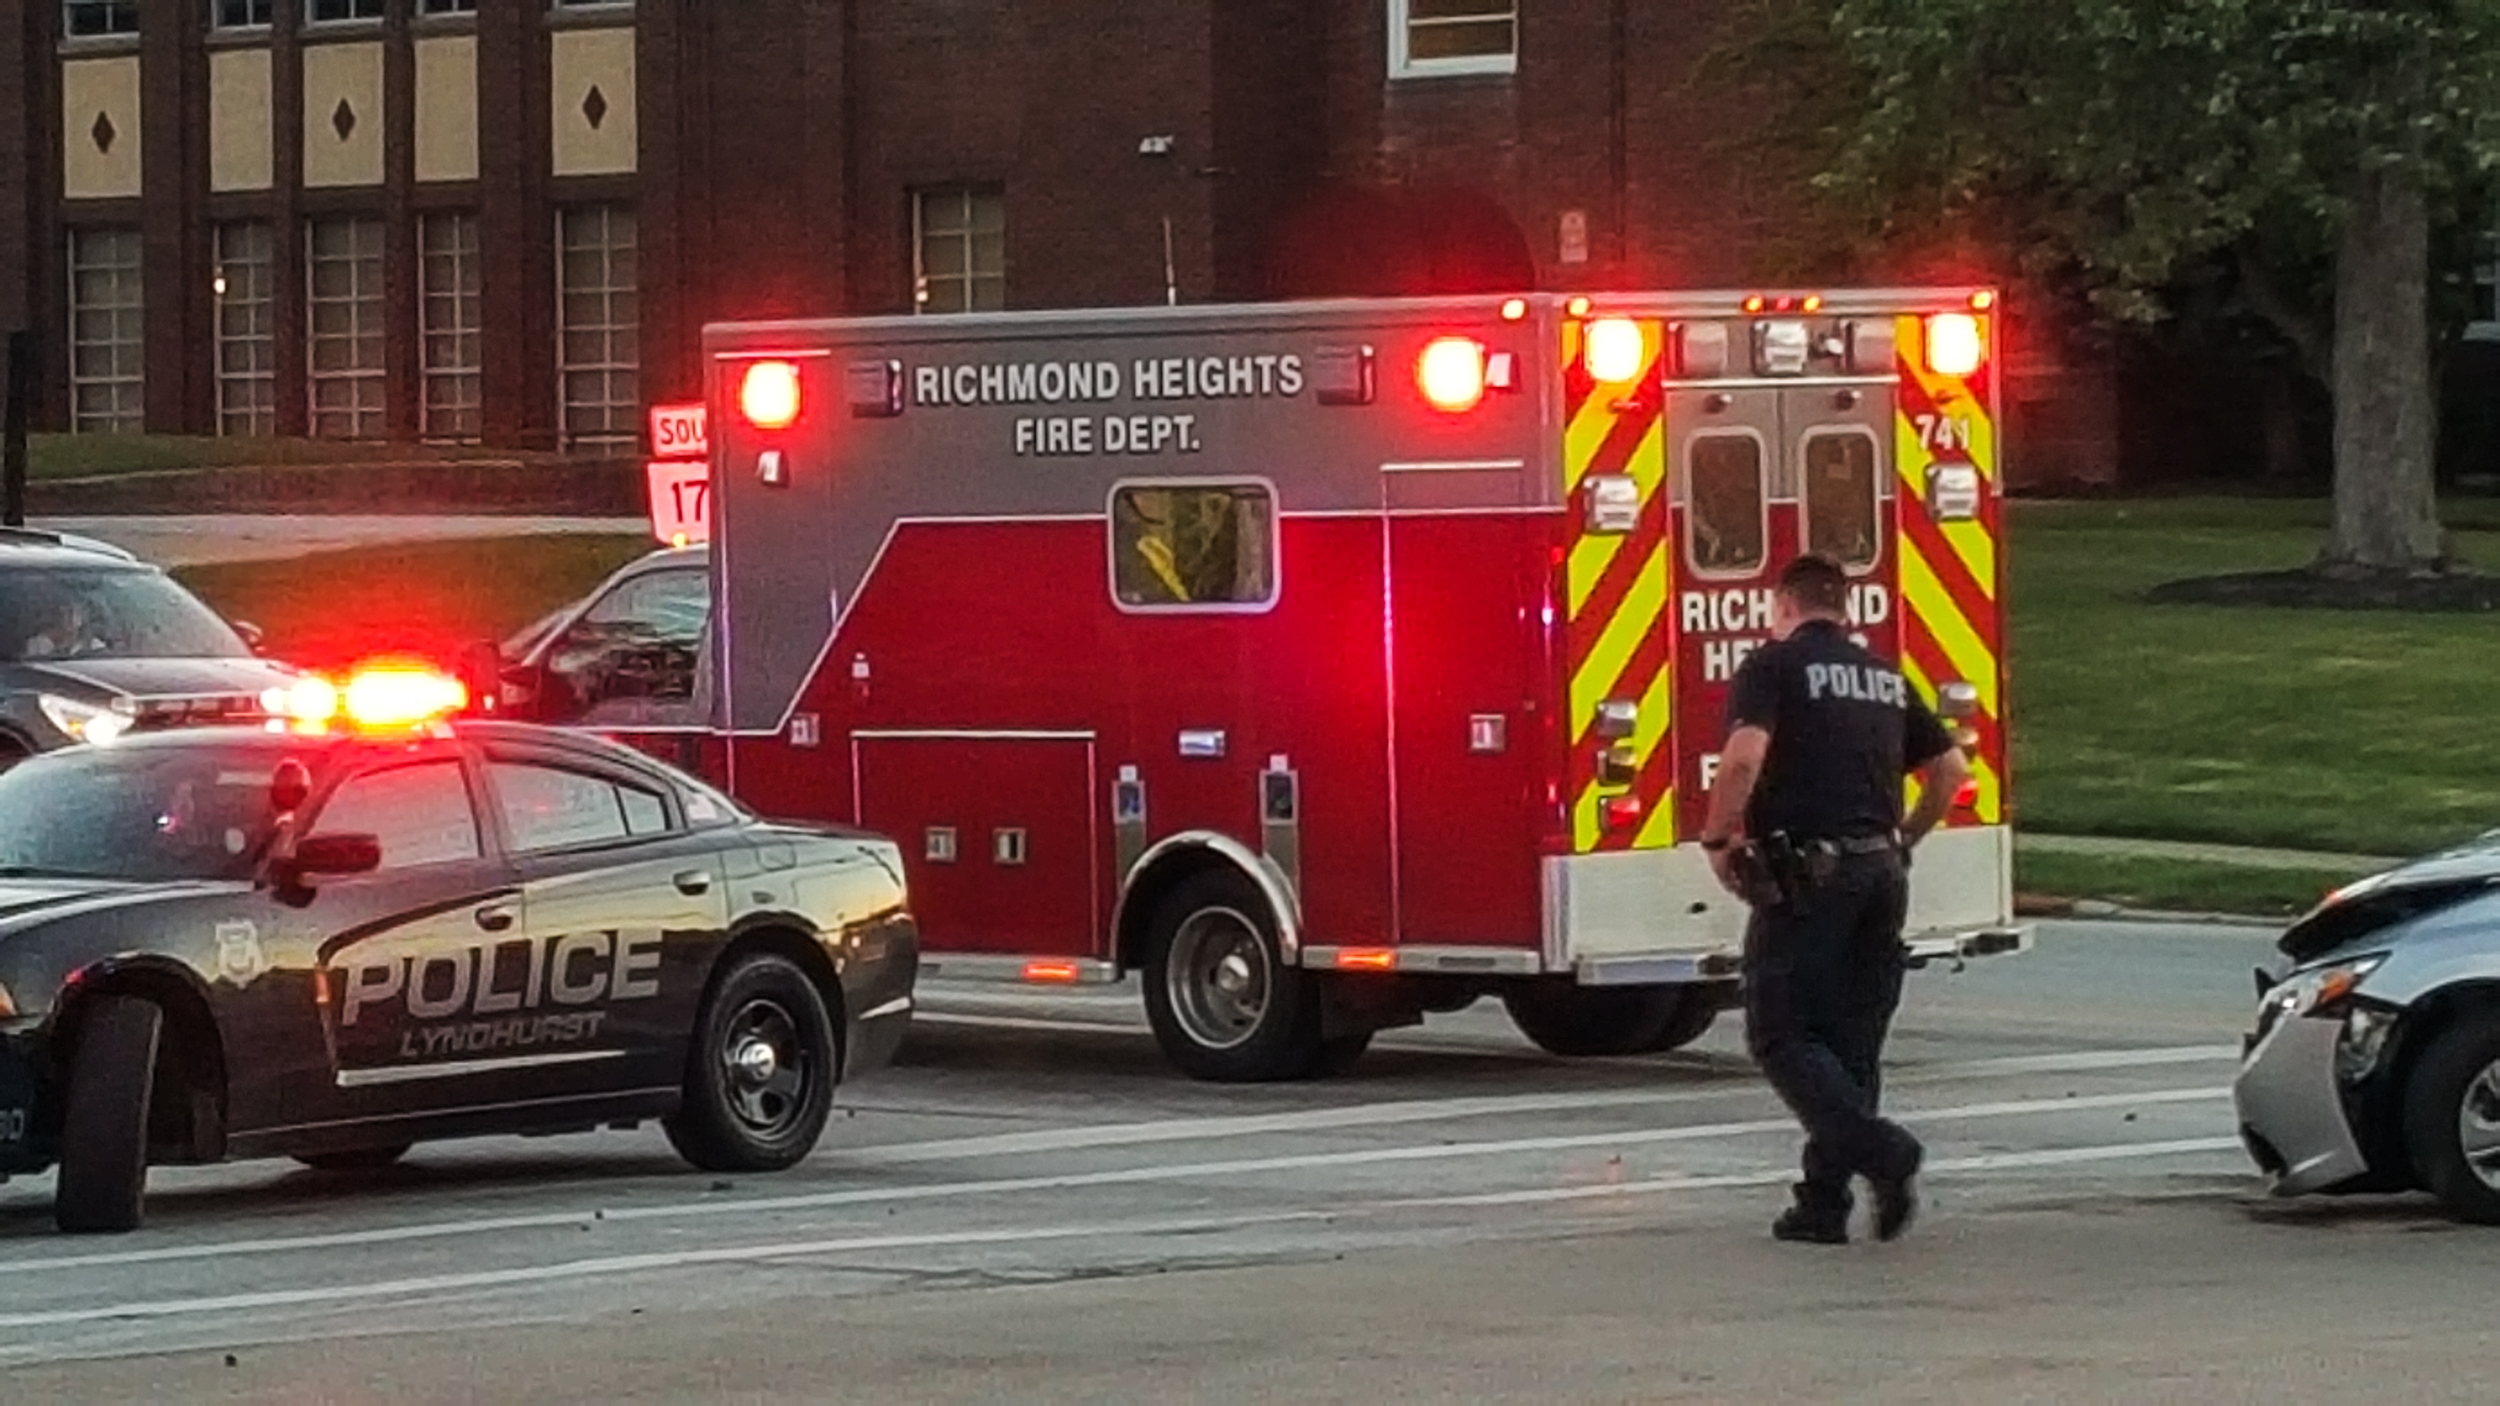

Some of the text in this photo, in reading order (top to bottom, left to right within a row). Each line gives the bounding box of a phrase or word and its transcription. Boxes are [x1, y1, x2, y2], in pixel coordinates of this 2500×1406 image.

[916, 355, 1303, 402] RICHMOND HEIGHTS
[1015, 415, 1200, 453] FIRE DEPT.
[1916, 414, 1969, 450] 741
[1682, 584, 1888, 632] RICHND
[1806, 662, 1908, 708] POLICE
[338, 927, 663, 1027] POLICE
[400, 1010, 607, 1056] LYNDHURST
